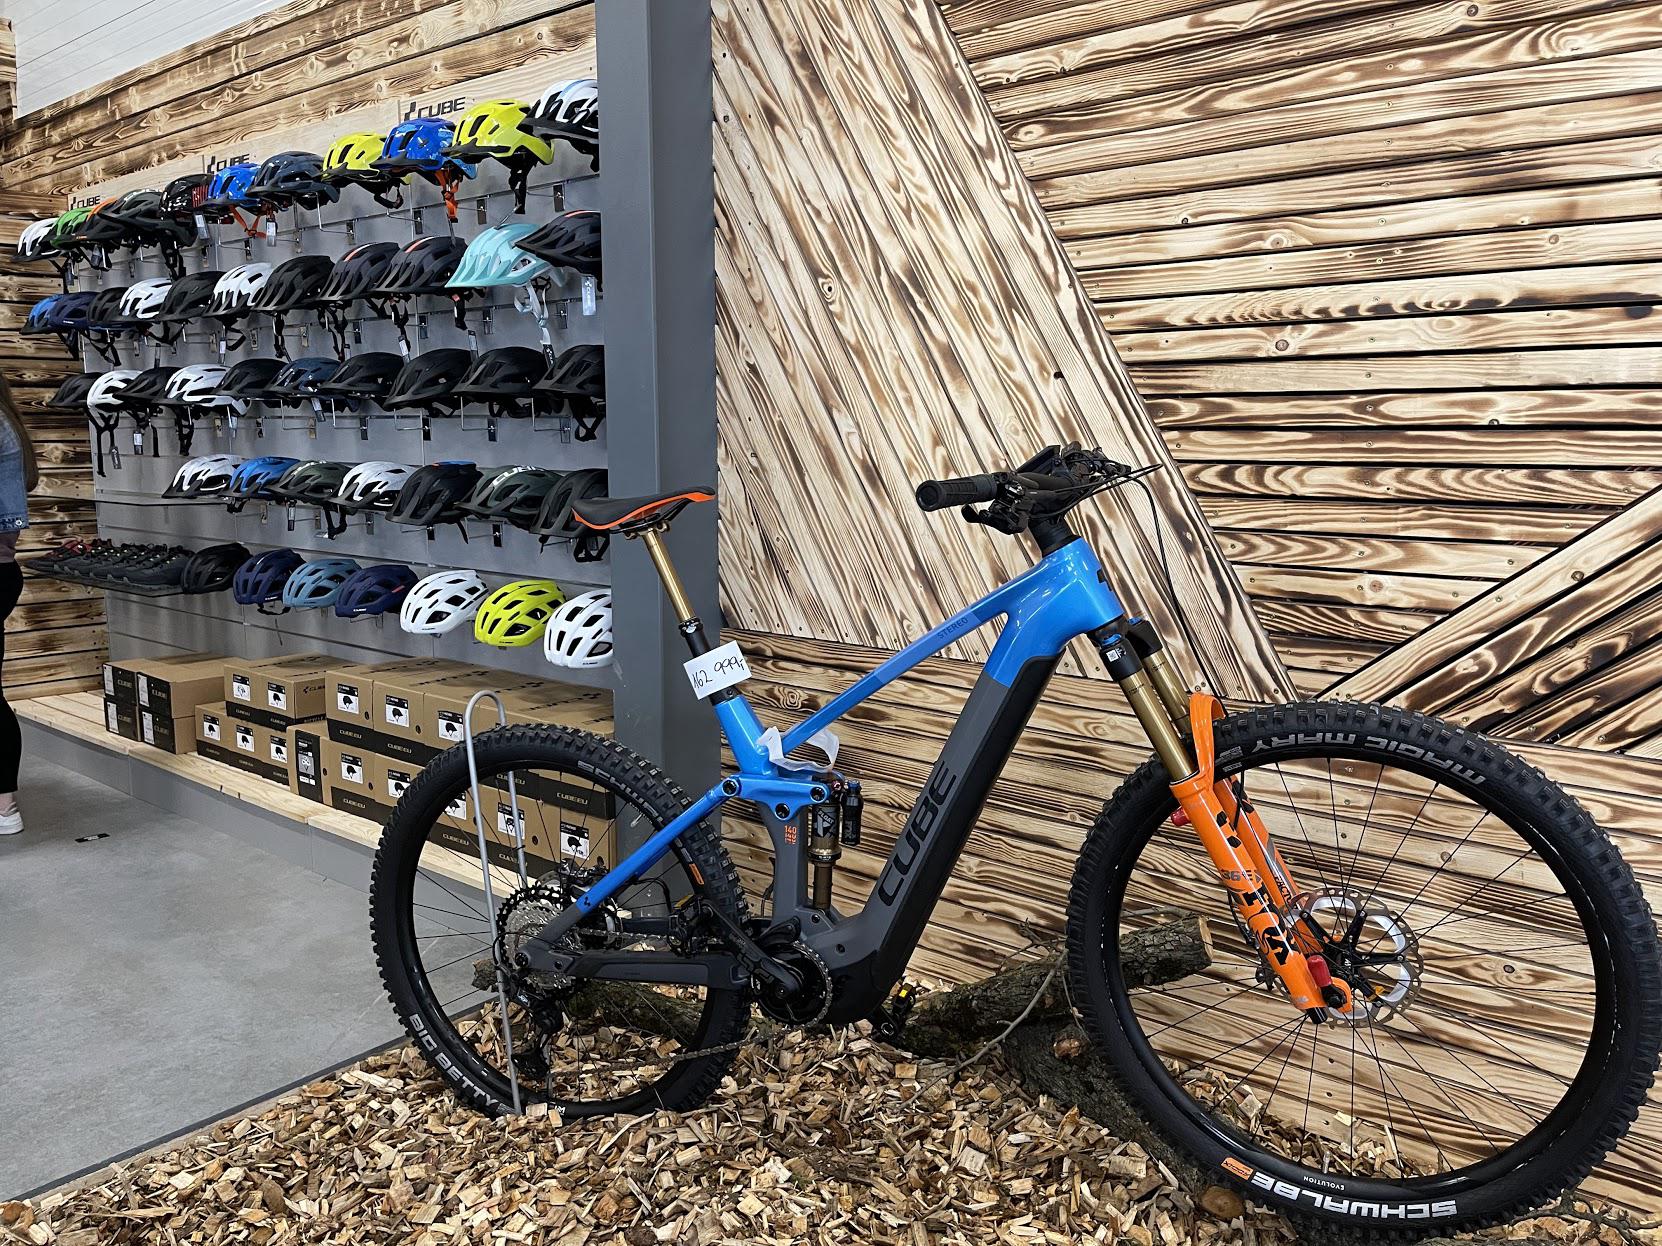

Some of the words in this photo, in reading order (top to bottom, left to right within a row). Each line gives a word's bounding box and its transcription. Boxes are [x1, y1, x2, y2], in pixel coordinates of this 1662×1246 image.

[417, 96, 466, 119] CUBE
[76, 195, 101, 209] CUBE
[937, 617, 969, 639] STEREO
[1252, 732, 1356, 753] MARY
[1364, 735, 1487, 786] MAGIC
[817, 809, 835, 825] FLOAT
[877, 760, 957, 907] CUBE
[1243, 881, 1300, 966] FOX
[408, 1013, 438, 1052] BIG
[434, 1052, 499, 1106] BETTY
[1303, 1175, 1345, 1191] EVOLUTION
[1250, 1171, 1458, 1219] SCHWALBE
